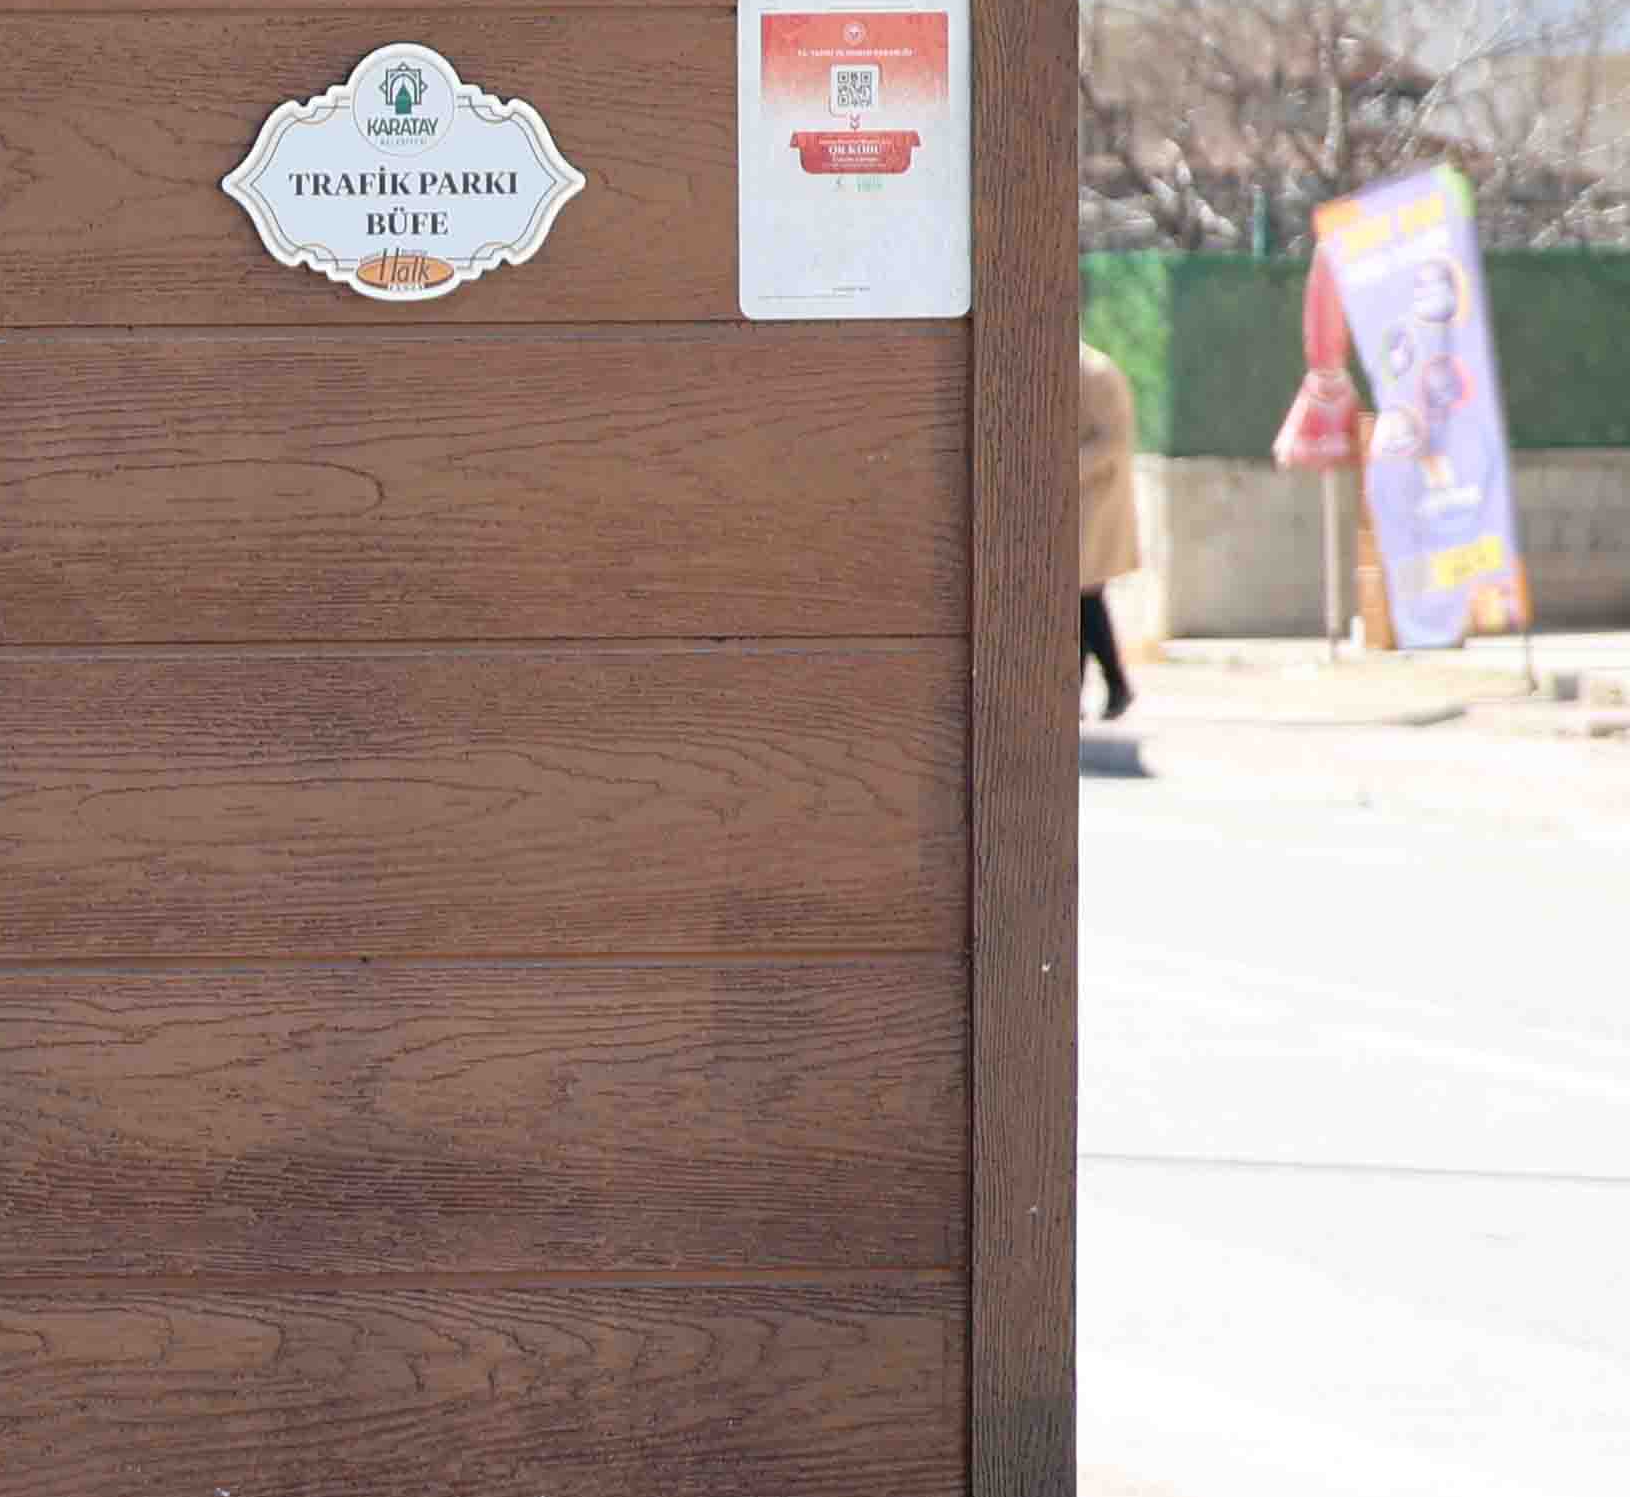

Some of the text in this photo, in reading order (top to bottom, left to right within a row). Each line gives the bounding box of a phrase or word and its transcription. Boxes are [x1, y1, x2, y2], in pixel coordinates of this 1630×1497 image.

[367, 118, 438, 136] KARATAY
[289, 165, 519, 196] TRAFİK PARKI
[366, 206, 448, 236] BÜFE
[380, 247, 431, 283] Halk
